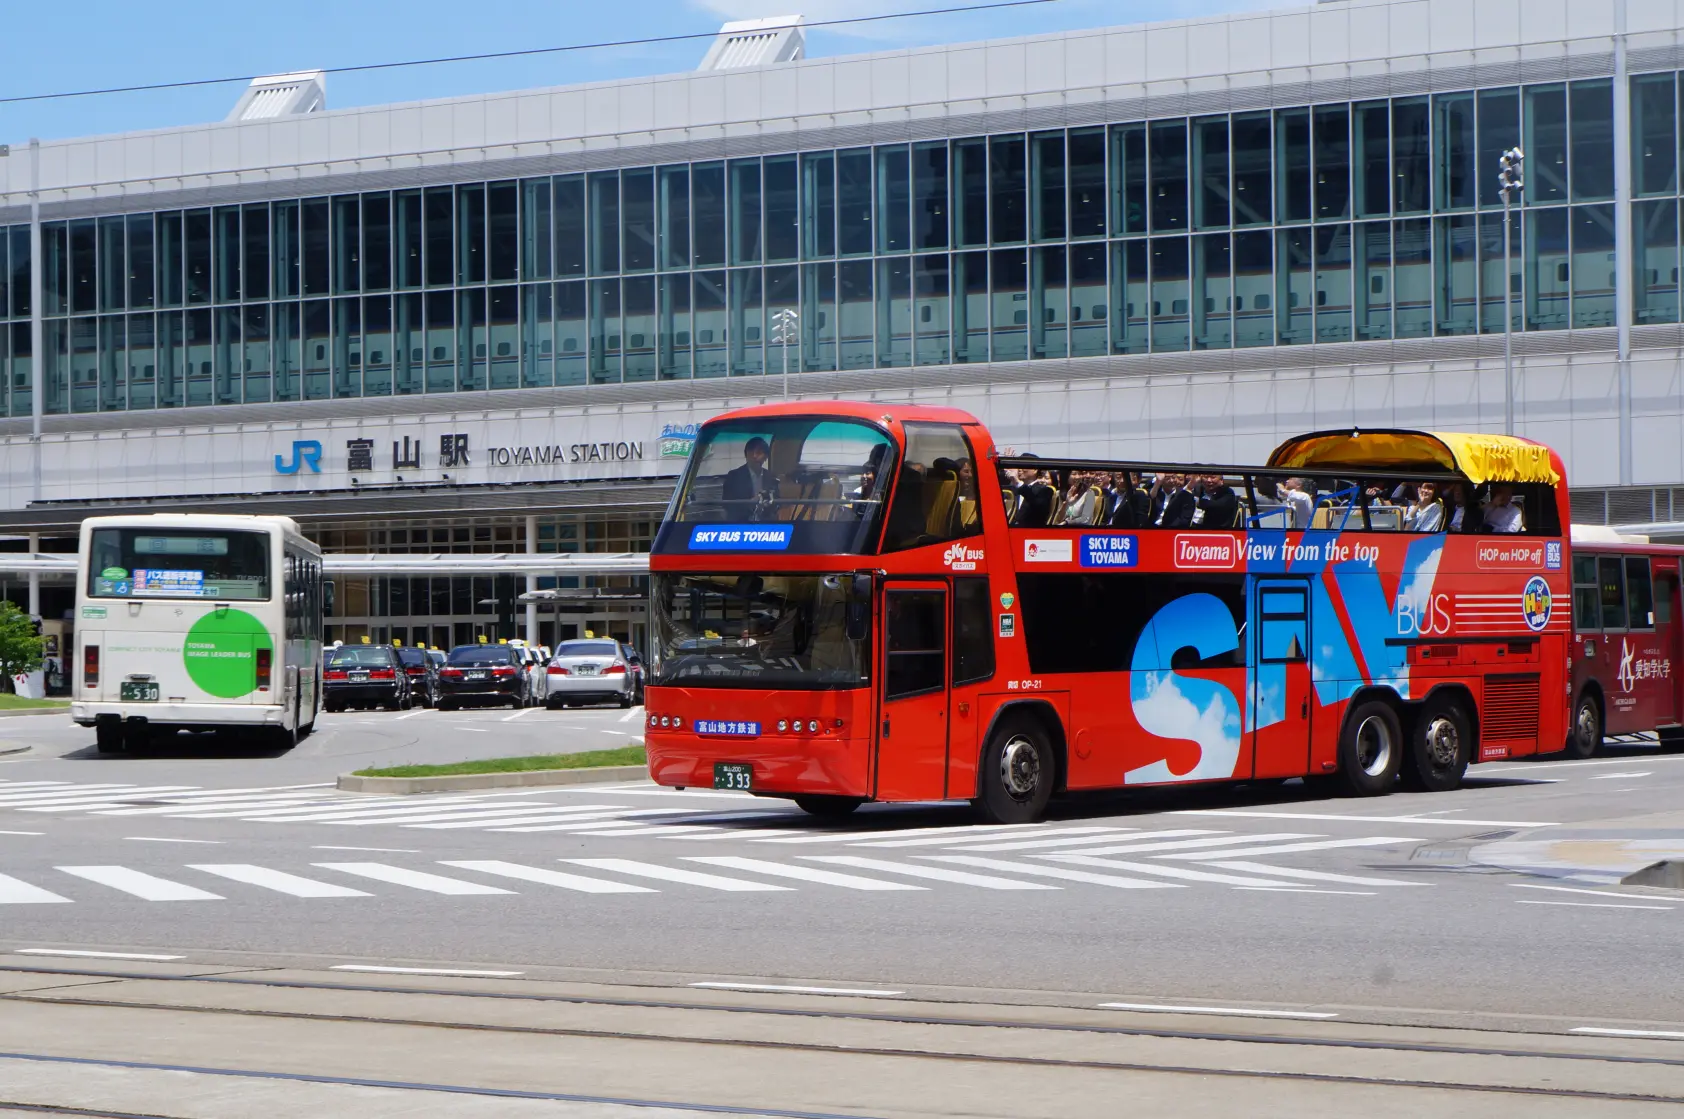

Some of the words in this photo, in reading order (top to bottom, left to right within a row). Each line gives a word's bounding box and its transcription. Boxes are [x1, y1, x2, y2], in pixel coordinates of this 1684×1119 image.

[274, 440, 322, 474] JR
[346, 433, 469, 471] 富山駅
[488, 445, 565, 466] TOYAMA
[571, 441, 643, 462] STATION
[695, 531, 718, 542] SKY
[718, 531, 741, 542] BUS
[743, 531, 785, 542] TOYAMA
[1088, 537, 1108, 550] SKY
[1110, 537, 1130, 549] BUS
[944, 543, 967, 565] SKY
[967, 550, 984, 560] BUS
[1179, 540, 1230, 563] Toyama
[1236, 539, 1276, 561] View
[1281, 538, 1320, 561] from
[1324, 538, 1349, 561] the
[1354, 541, 1379, 568] top
[1547, 543, 1560, 552] SKY
[1090, 552, 1129, 564] TOYAMA
[1479, 548, 1499, 561] HOP
[1499, 552, 1510, 561] on
[1510, 548, 1530, 561] HOP
[1530, 549, 1542, 564] off
[1547, 553, 1560, 562] BUS
[1397, 594, 1451, 635] BUS
[1531, 613, 1545, 625] BUS
[1022, 680, 1042, 690] OP-21
[698, 721, 757, 735] 富山地方鉄道
